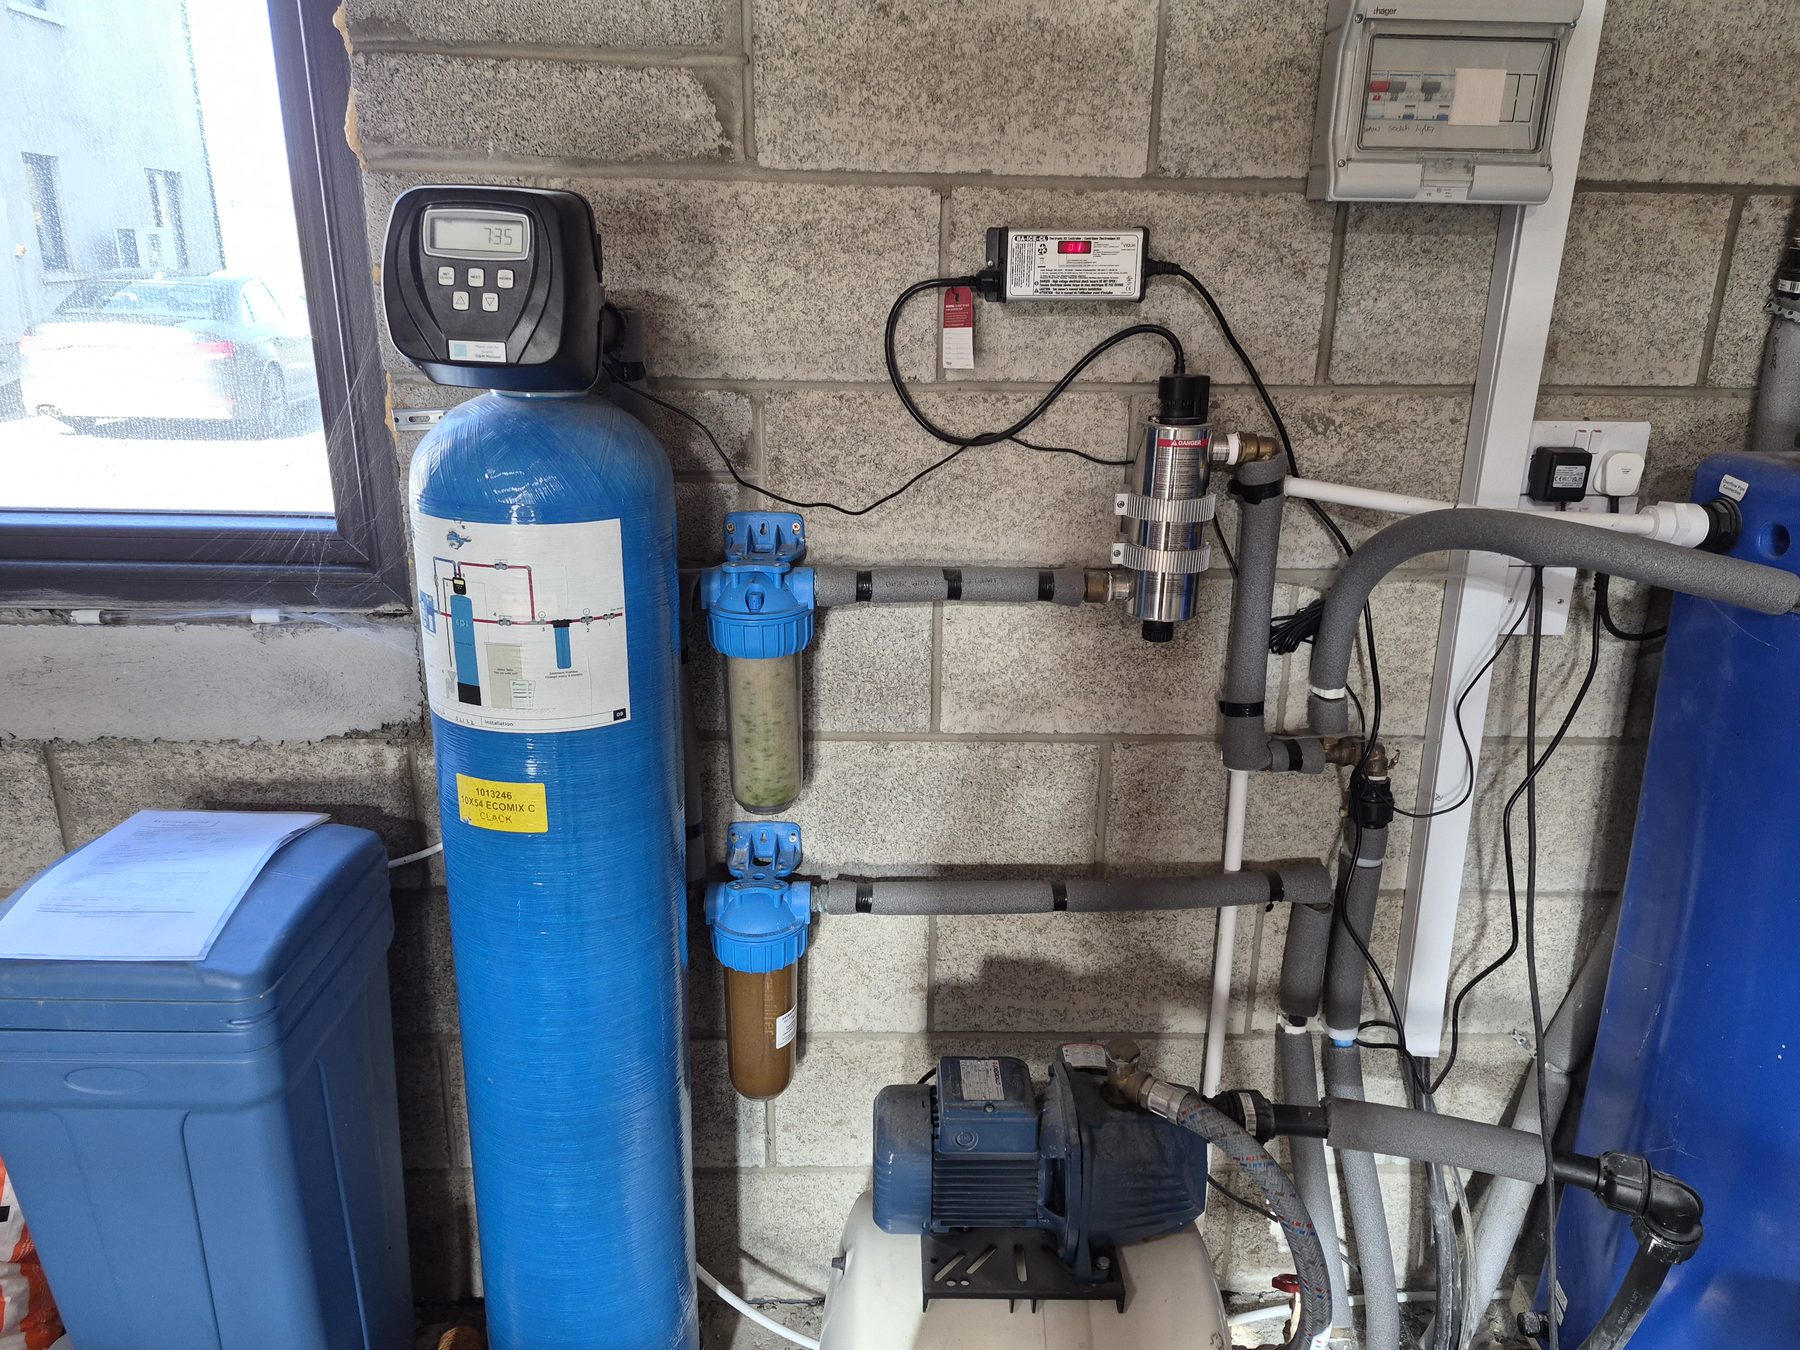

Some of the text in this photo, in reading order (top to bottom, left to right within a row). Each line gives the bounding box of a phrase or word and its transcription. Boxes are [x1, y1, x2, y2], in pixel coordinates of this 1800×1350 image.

[476, 788, 512, 800] 1013246
[461, 795, 535, 812] 10X54 ECOMIX C
[480, 811, 512, 823] CLACK
